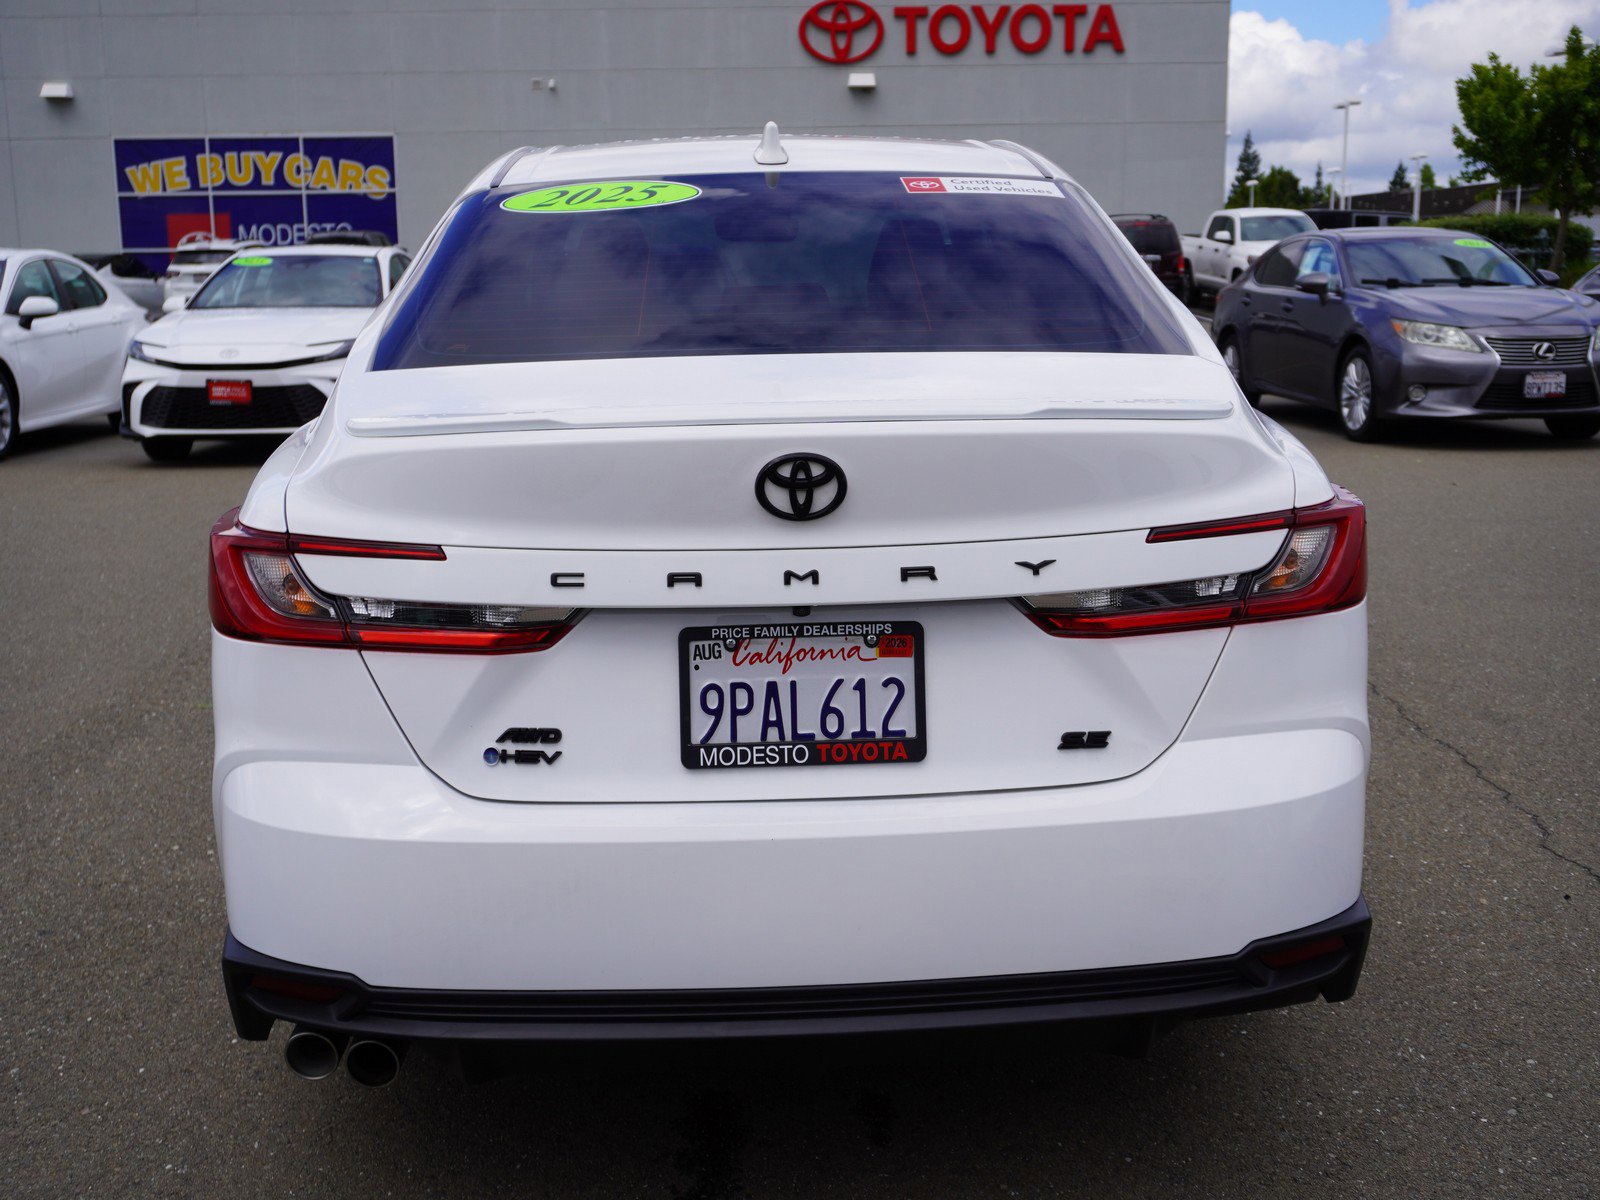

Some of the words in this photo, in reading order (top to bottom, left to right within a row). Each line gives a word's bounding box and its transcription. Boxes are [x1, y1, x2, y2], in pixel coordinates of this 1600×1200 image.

[893, 3, 1126, 56] TOYOTA
[125, 155, 191, 198] WE
[196, 151, 283, 188] BUY
[283, 153, 391, 200] CARS
[950, 178, 1012, 186] Certified
[528, 184, 670, 209] 2025
[993, 185, 1053, 195] Vehicles
[550, 559, 1057, 588] CAMRY
[711, 626, 750, 639] PRICE
[754, 625, 799, 637] FAMILY
[803, 623, 893, 636] DEALERSHIPS
[692, 642, 722, 661] AUG
[731, 637, 878, 675] California
[699, 677, 907, 744] 9PAL612
[495, 727, 562, 744] AWD
[1057, 730, 1112, 750] SE
[500, 749, 562, 765] HEV
[700, 744, 809, 767] MODESTO
[816, 742, 909, 763] TOYOTA
